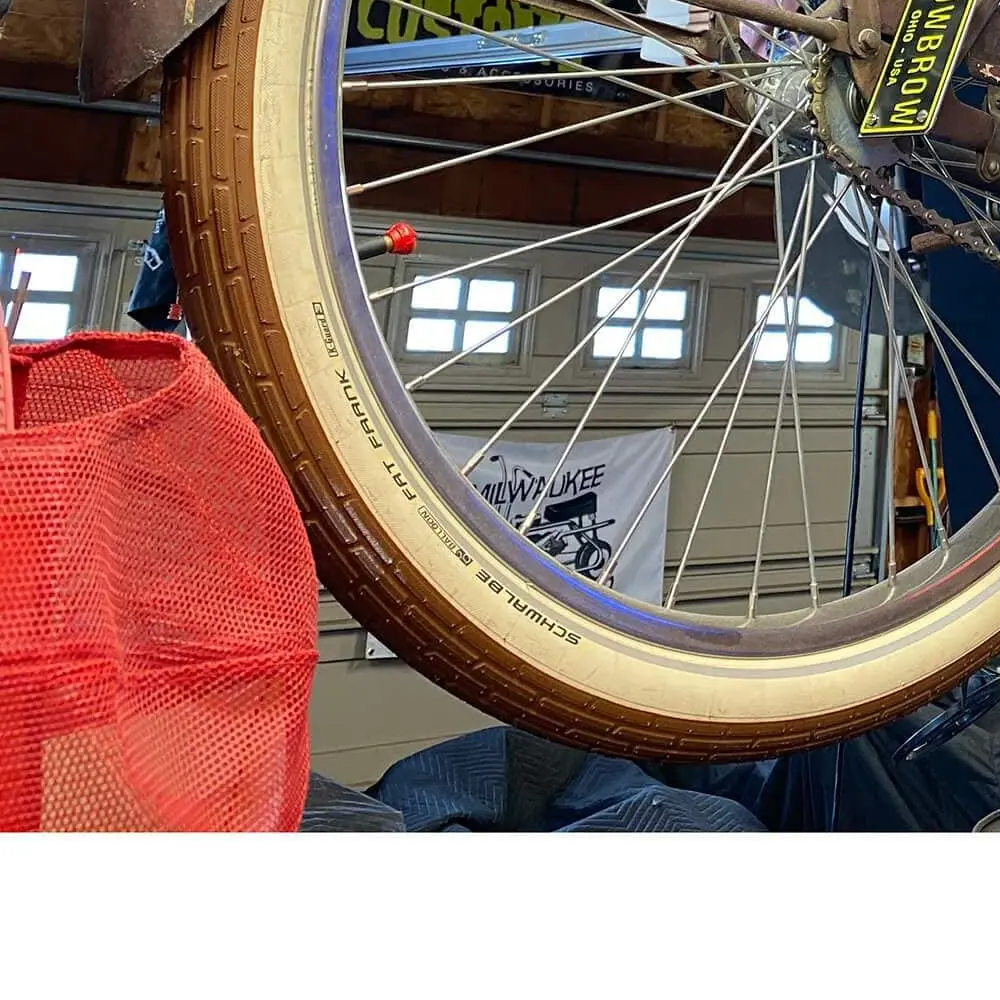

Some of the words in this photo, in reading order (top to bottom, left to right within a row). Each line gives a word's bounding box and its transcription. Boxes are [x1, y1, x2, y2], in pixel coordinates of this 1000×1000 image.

[902, 9, 922, 43] OHIO
[886, 58, 905, 87] USA
[319, 317, 338, 357] K-Guard
[334, 369, 384, 449] FRANK
[382, 460, 417, 501] FAT
[473, 463, 606, 506] MILWAUKEE
[475, 568, 582, 646] SCHWALBE
